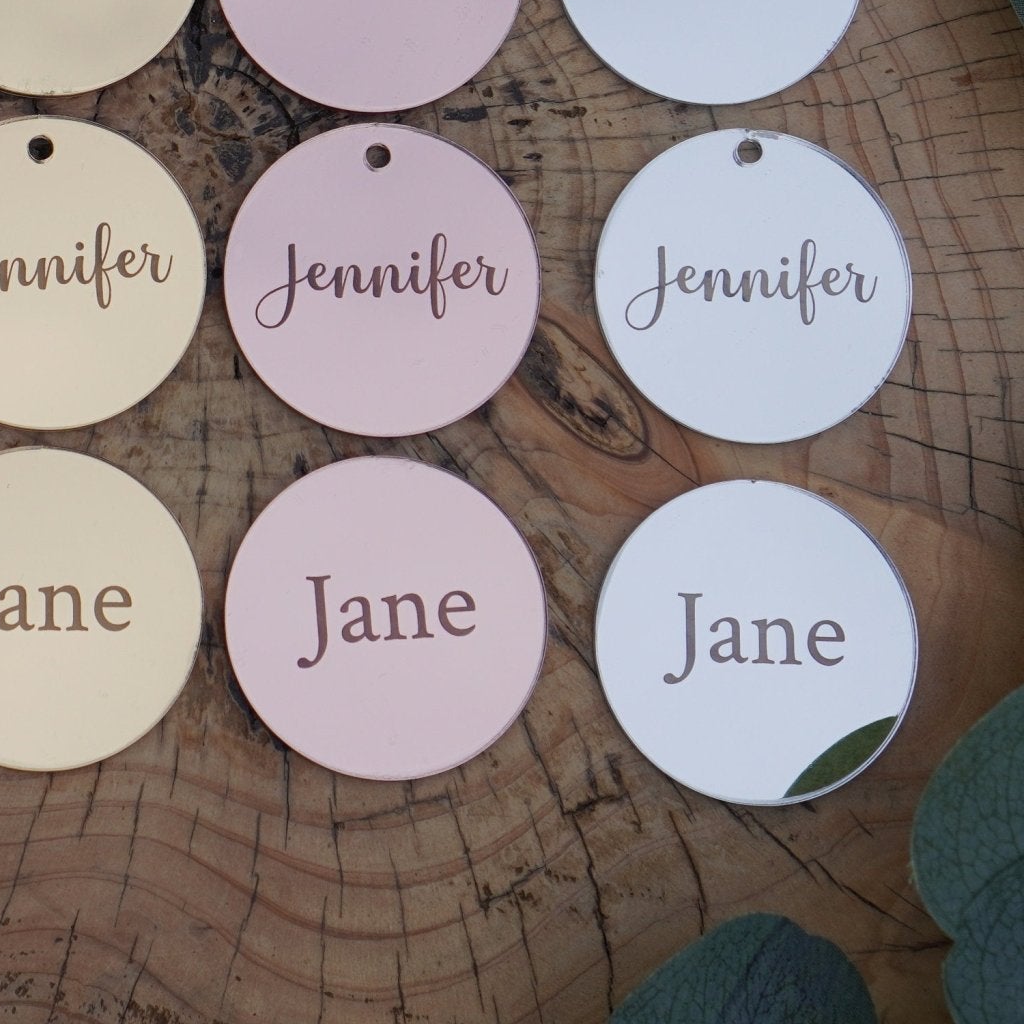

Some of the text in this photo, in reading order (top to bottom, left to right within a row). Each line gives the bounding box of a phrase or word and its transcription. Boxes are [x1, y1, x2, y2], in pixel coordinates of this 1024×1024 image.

[255, 233, 508, 329] Jennifer
[625, 239, 878, 331] Jennifer
[297, 575, 477, 669] Jane
[663, 592, 846, 684] Jane
